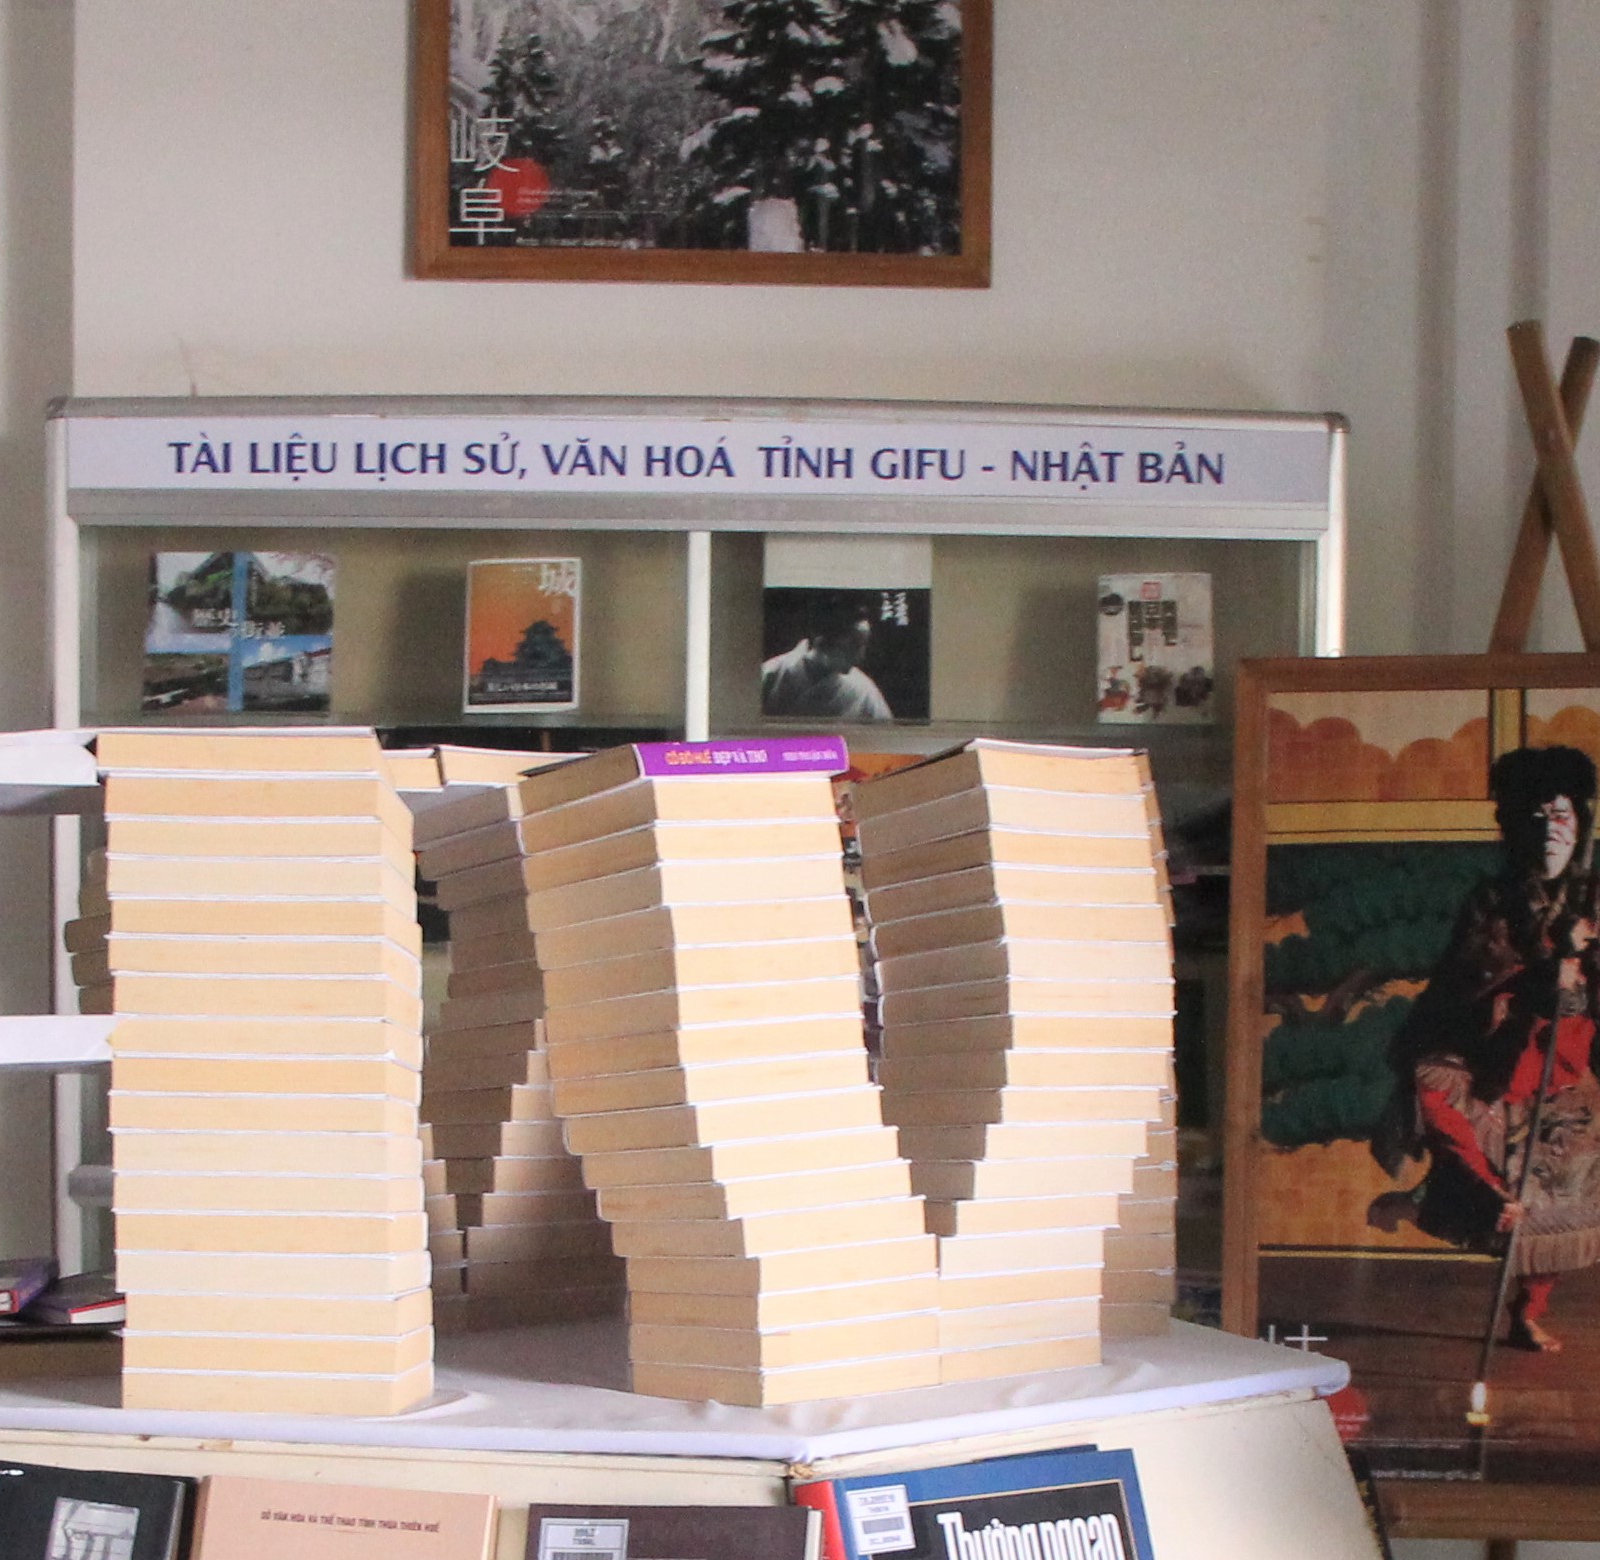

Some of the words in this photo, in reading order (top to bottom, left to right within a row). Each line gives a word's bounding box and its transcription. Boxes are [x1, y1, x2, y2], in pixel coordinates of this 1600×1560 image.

[167, 433, 232, 475] TÀI
[249, 433, 338, 481] LIỆU
[354, 441, 449, 481] LỊCH
[462, 433, 527, 480] SỬ,
[541, 438, 628, 477] VĂN
[643, 437, 736, 478] HOÁ
[757, 436, 854, 479] TỈNH
[870, 447, 966, 481] GIFU
[1010, 441, 1125, 490] NHẬT
[1137, 441, 1225, 486] BẢN
